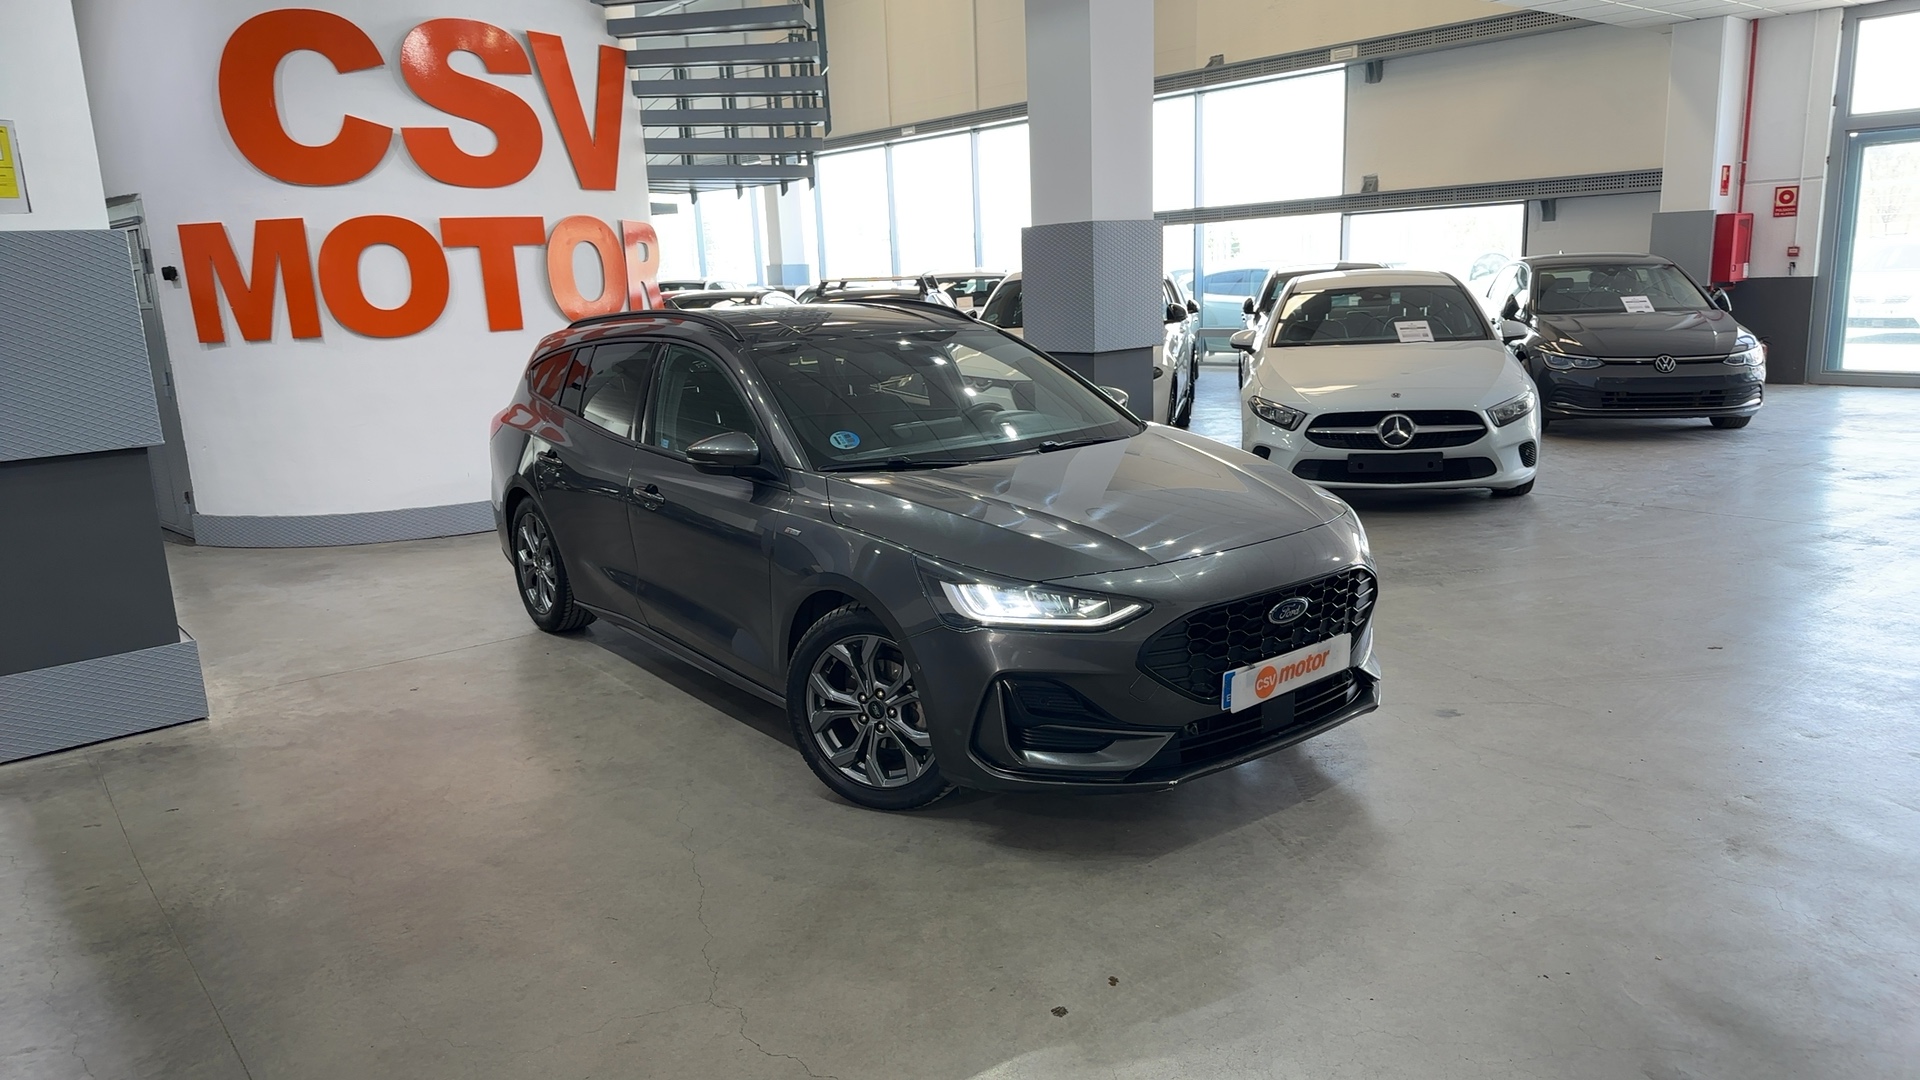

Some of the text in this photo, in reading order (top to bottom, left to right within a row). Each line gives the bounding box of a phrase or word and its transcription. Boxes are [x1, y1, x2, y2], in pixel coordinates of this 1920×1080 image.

[218, 8, 626, 191] CSV
[178, 214, 665, 343] MOTOR
[1279, 604, 1301, 619] Ford
[1278, 650, 1331, 684] motor
